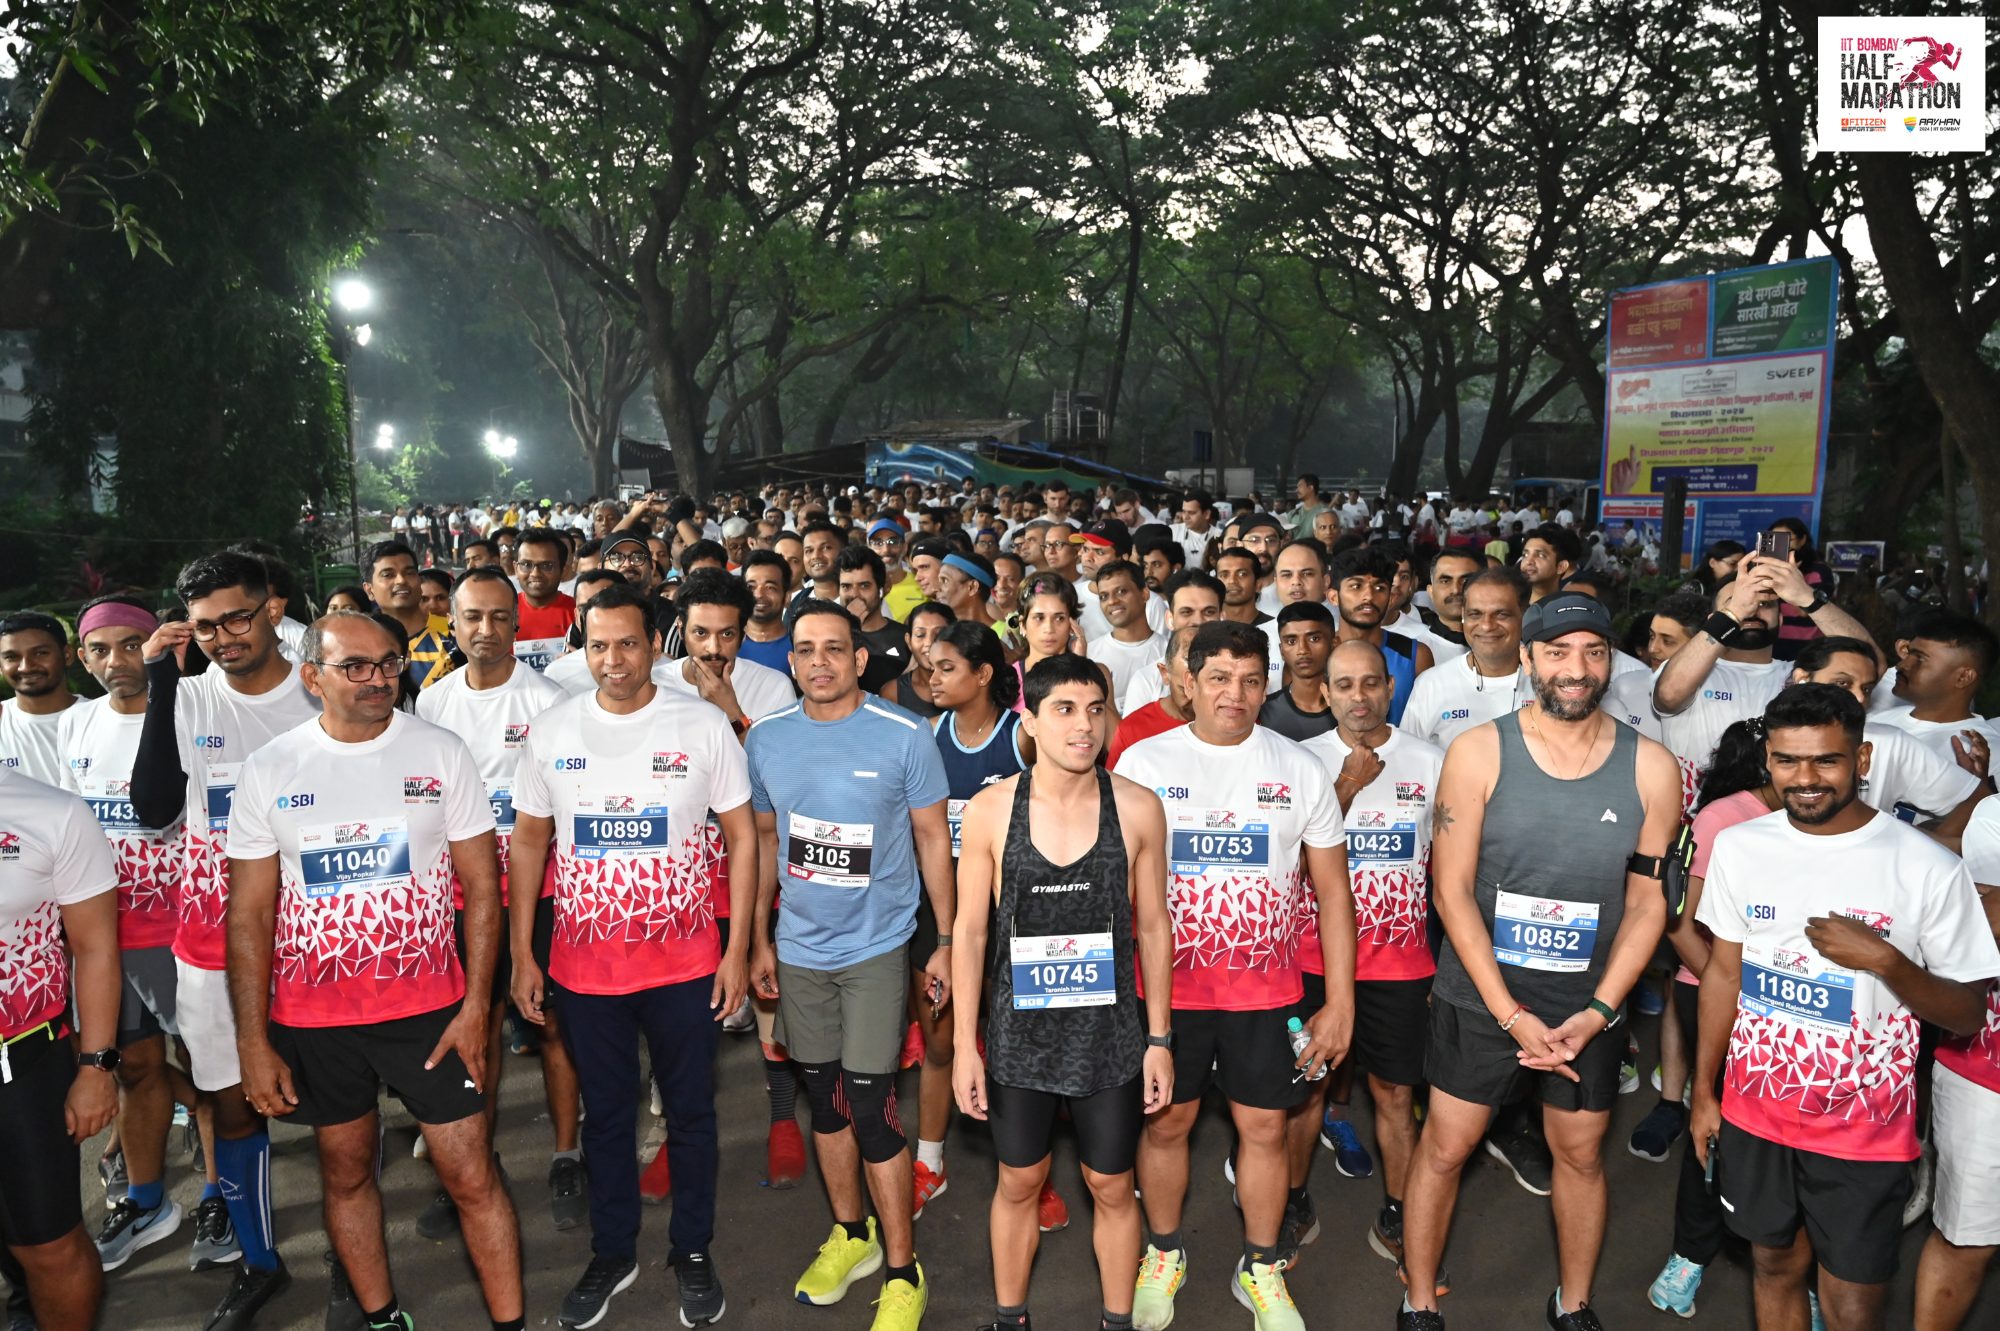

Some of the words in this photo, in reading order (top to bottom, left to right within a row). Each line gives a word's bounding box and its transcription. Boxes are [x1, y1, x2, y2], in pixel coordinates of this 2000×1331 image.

[1737, 286, 1754, 305] इथे
[1755, 280, 1785, 301] सगळी
[1736, 302, 1768, 323] सारखी
[1770, 299, 1799, 318] आहेत
[1715, 691, 1732, 701] SBI
[1451, 709, 1469, 719] SBI
[207, 736, 224, 749] SBI
[566, 758, 586, 770] SBI
[653, 756, 669, 764] HALF
[652, 764, 688, 773] MARATHON
[404, 789, 441, 798] MARATHON
[1168, 787, 1189, 799] SBI
[1397, 794, 1426, 802] MARATHON
[291, 794, 314, 807] SBI
[1258, 795, 1291, 804] MARATHON
[589, 820, 652, 839] 10899
[1206, 821, 1236, 829] MARATHON
[335, 828, 350, 836] HALF
[336, 834, 370, 844] MARATHON
[1346, 834, 1402, 852] 10423
[1189, 835, 1253, 856] 10753
[320, 848, 390, 874] 11040
[804, 844, 851, 867] 3105
[336, 873, 352, 881] Vijay
[352, 871, 376, 879] Popkar
[1031, 882, 1090, 893] GYMBASTIC
[1531, 903, 1546, 912] HALF
[1754, 905, 1775, 920] SBI
[1530, 911, 1564, 922] MARATHON
[1511, 923, 1580, 950] 10852
[1046, 949, 1078, 957] MARATHON
[1526, 947, 1548, 956] Sachin
[1774, 951, 1789, 961] HALF
[1773, 960, 1808, 975] MARATHON
[1030, 964, 1098, 986] 10745
[1757, 972, 1829, 1008] 11803
[1786, 1002, 1822, 1017] Rajnikanth
